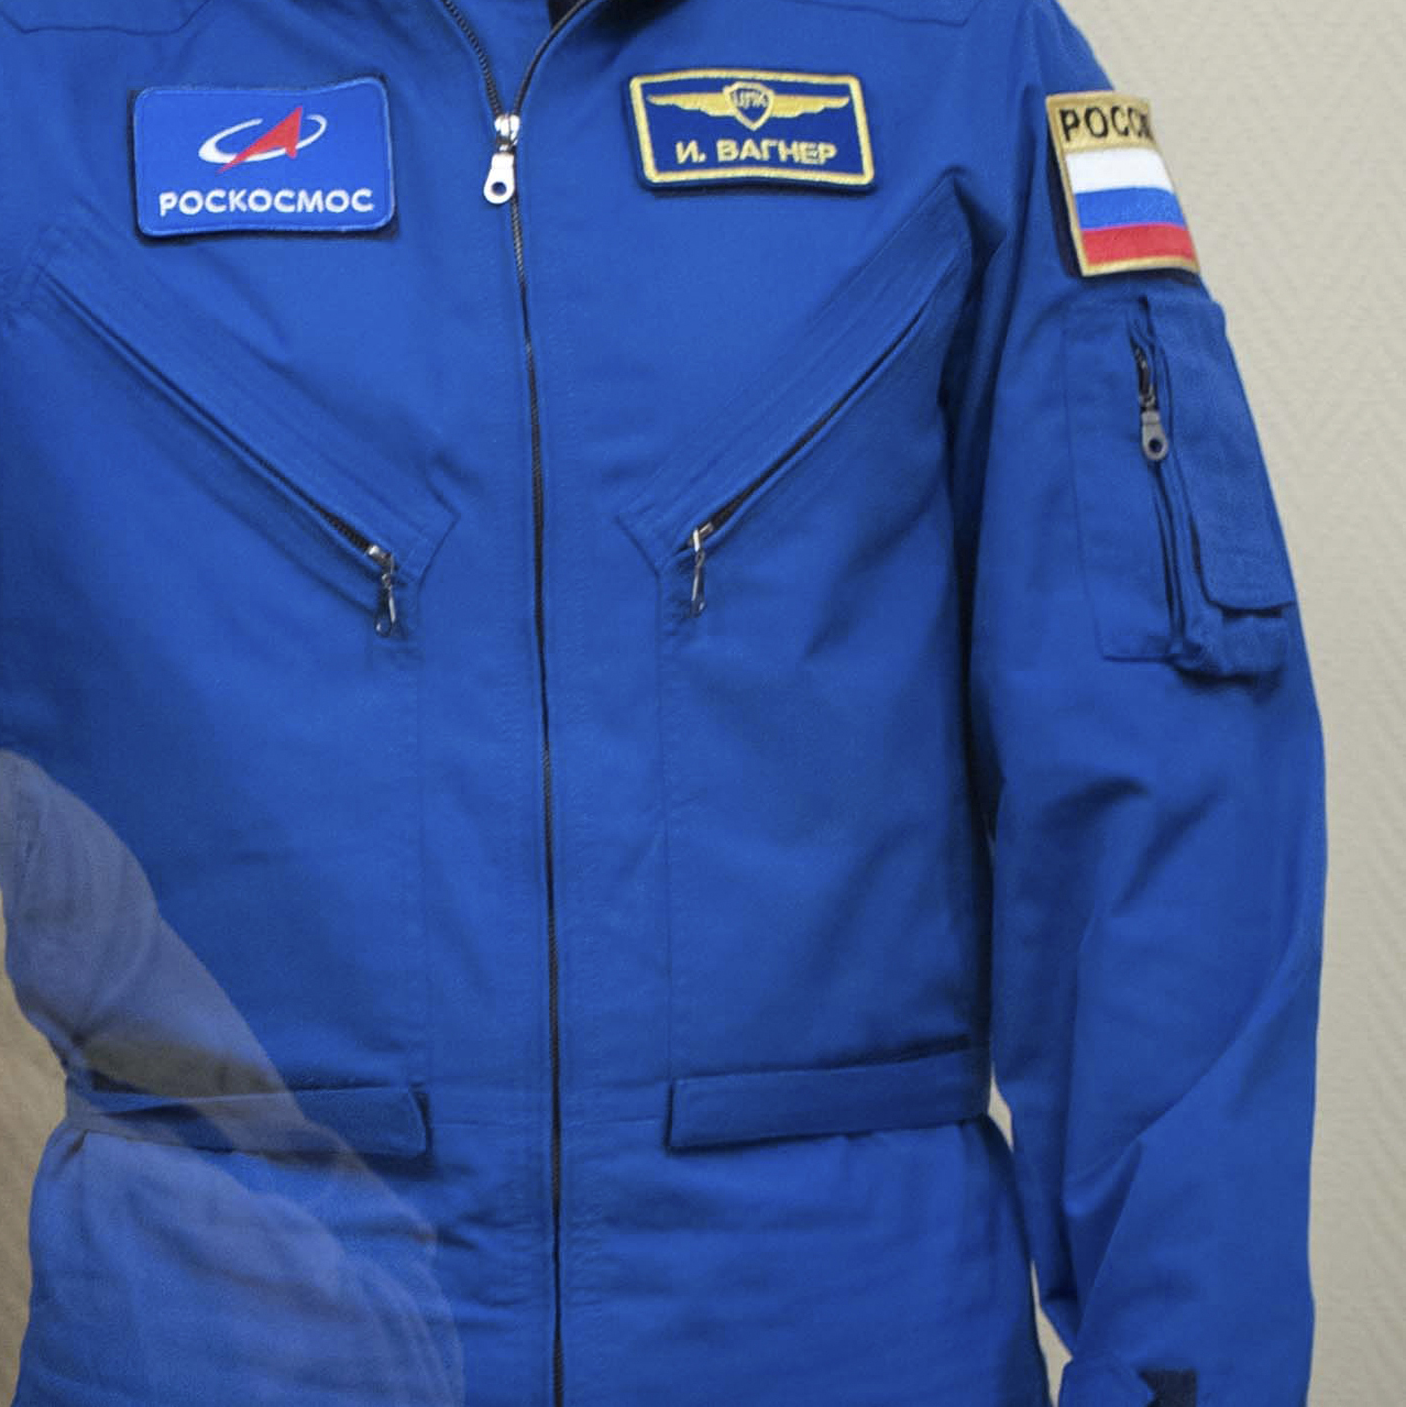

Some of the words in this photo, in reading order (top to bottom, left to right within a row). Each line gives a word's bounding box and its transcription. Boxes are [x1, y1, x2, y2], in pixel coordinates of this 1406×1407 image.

[676, 139, 706, 164] И.
[716, 139, 839, 164] ВАГНЕР
[158, 187, 374, 218] РОСКОСМОС
